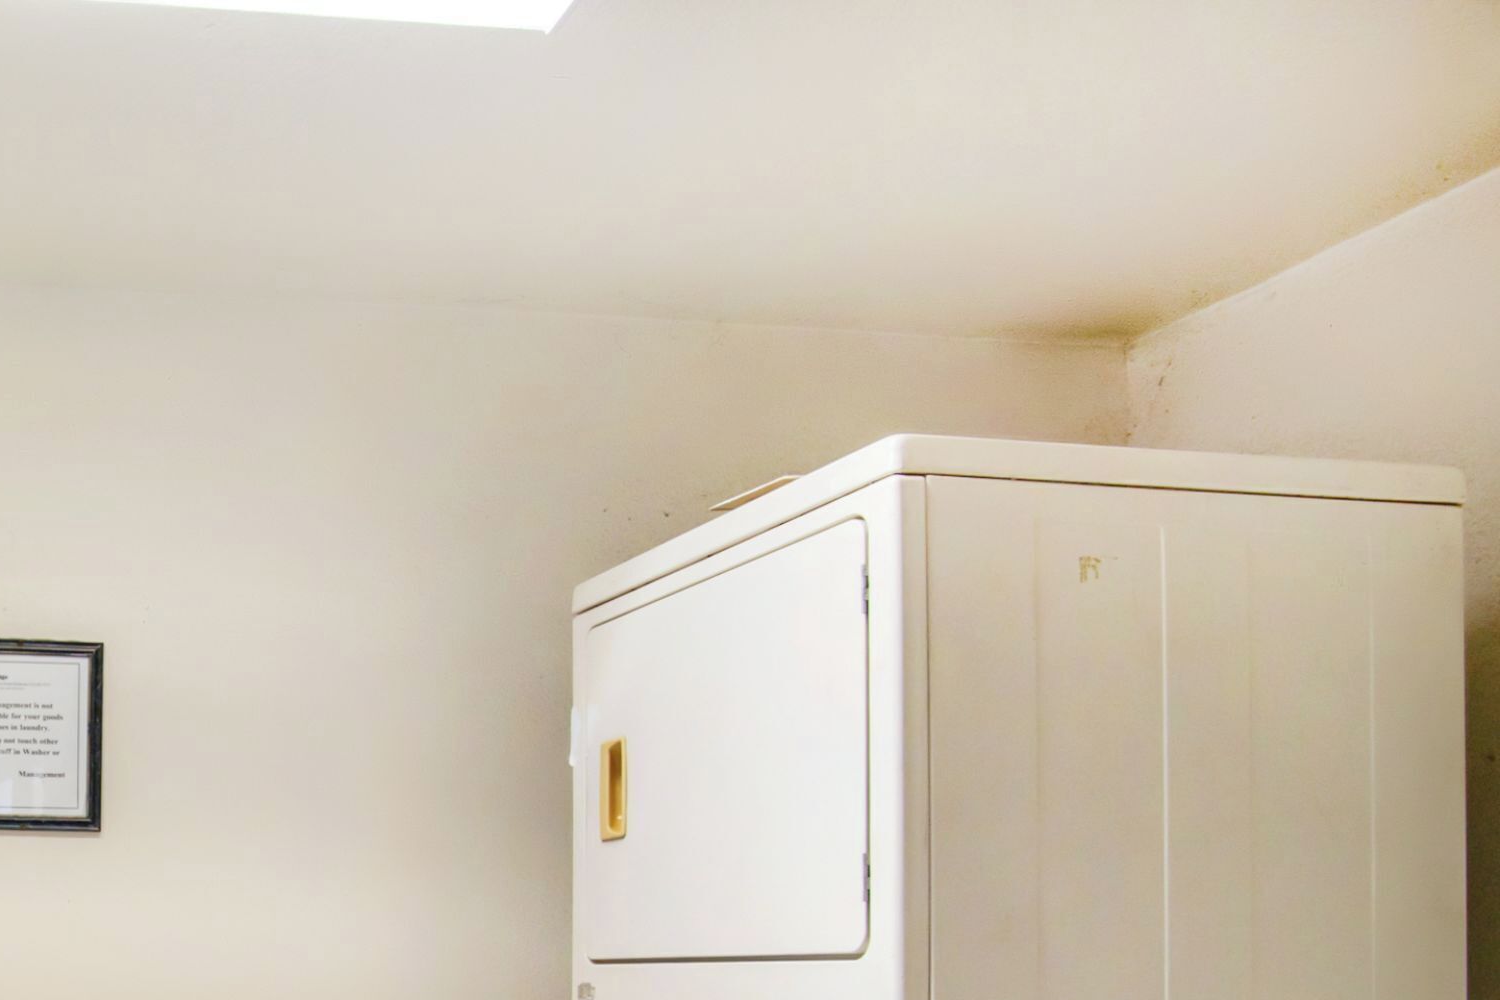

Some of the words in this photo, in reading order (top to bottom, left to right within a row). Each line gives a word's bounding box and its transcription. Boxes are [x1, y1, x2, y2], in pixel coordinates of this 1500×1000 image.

[42, 713, 64, 721] goods
[17, 737, 38, 745] touch
[22, 748, 50, 756] Washer
